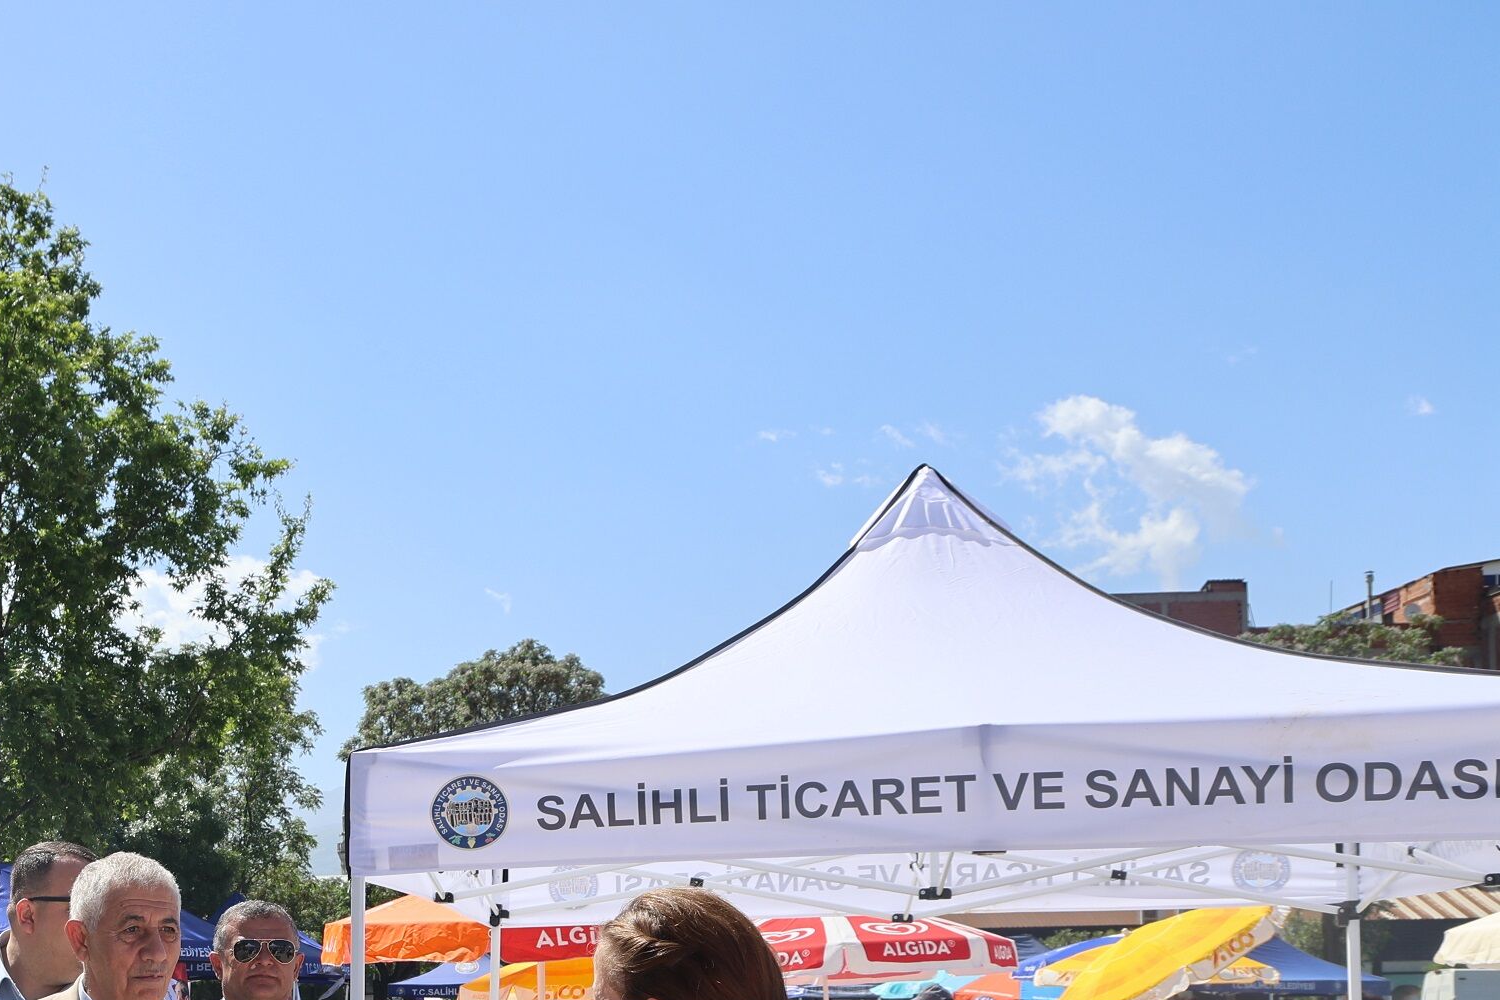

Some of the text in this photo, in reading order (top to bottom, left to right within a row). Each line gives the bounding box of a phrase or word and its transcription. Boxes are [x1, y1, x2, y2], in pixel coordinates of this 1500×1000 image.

[469, 778, 480, 786] VE
[536, 778, 730, 831] SALİHLİ
[746, 774, 977, 821] TİCARET
[993, 771, 1066, 811] VE
[1084, 756, 1294, 809] SANAYİ
